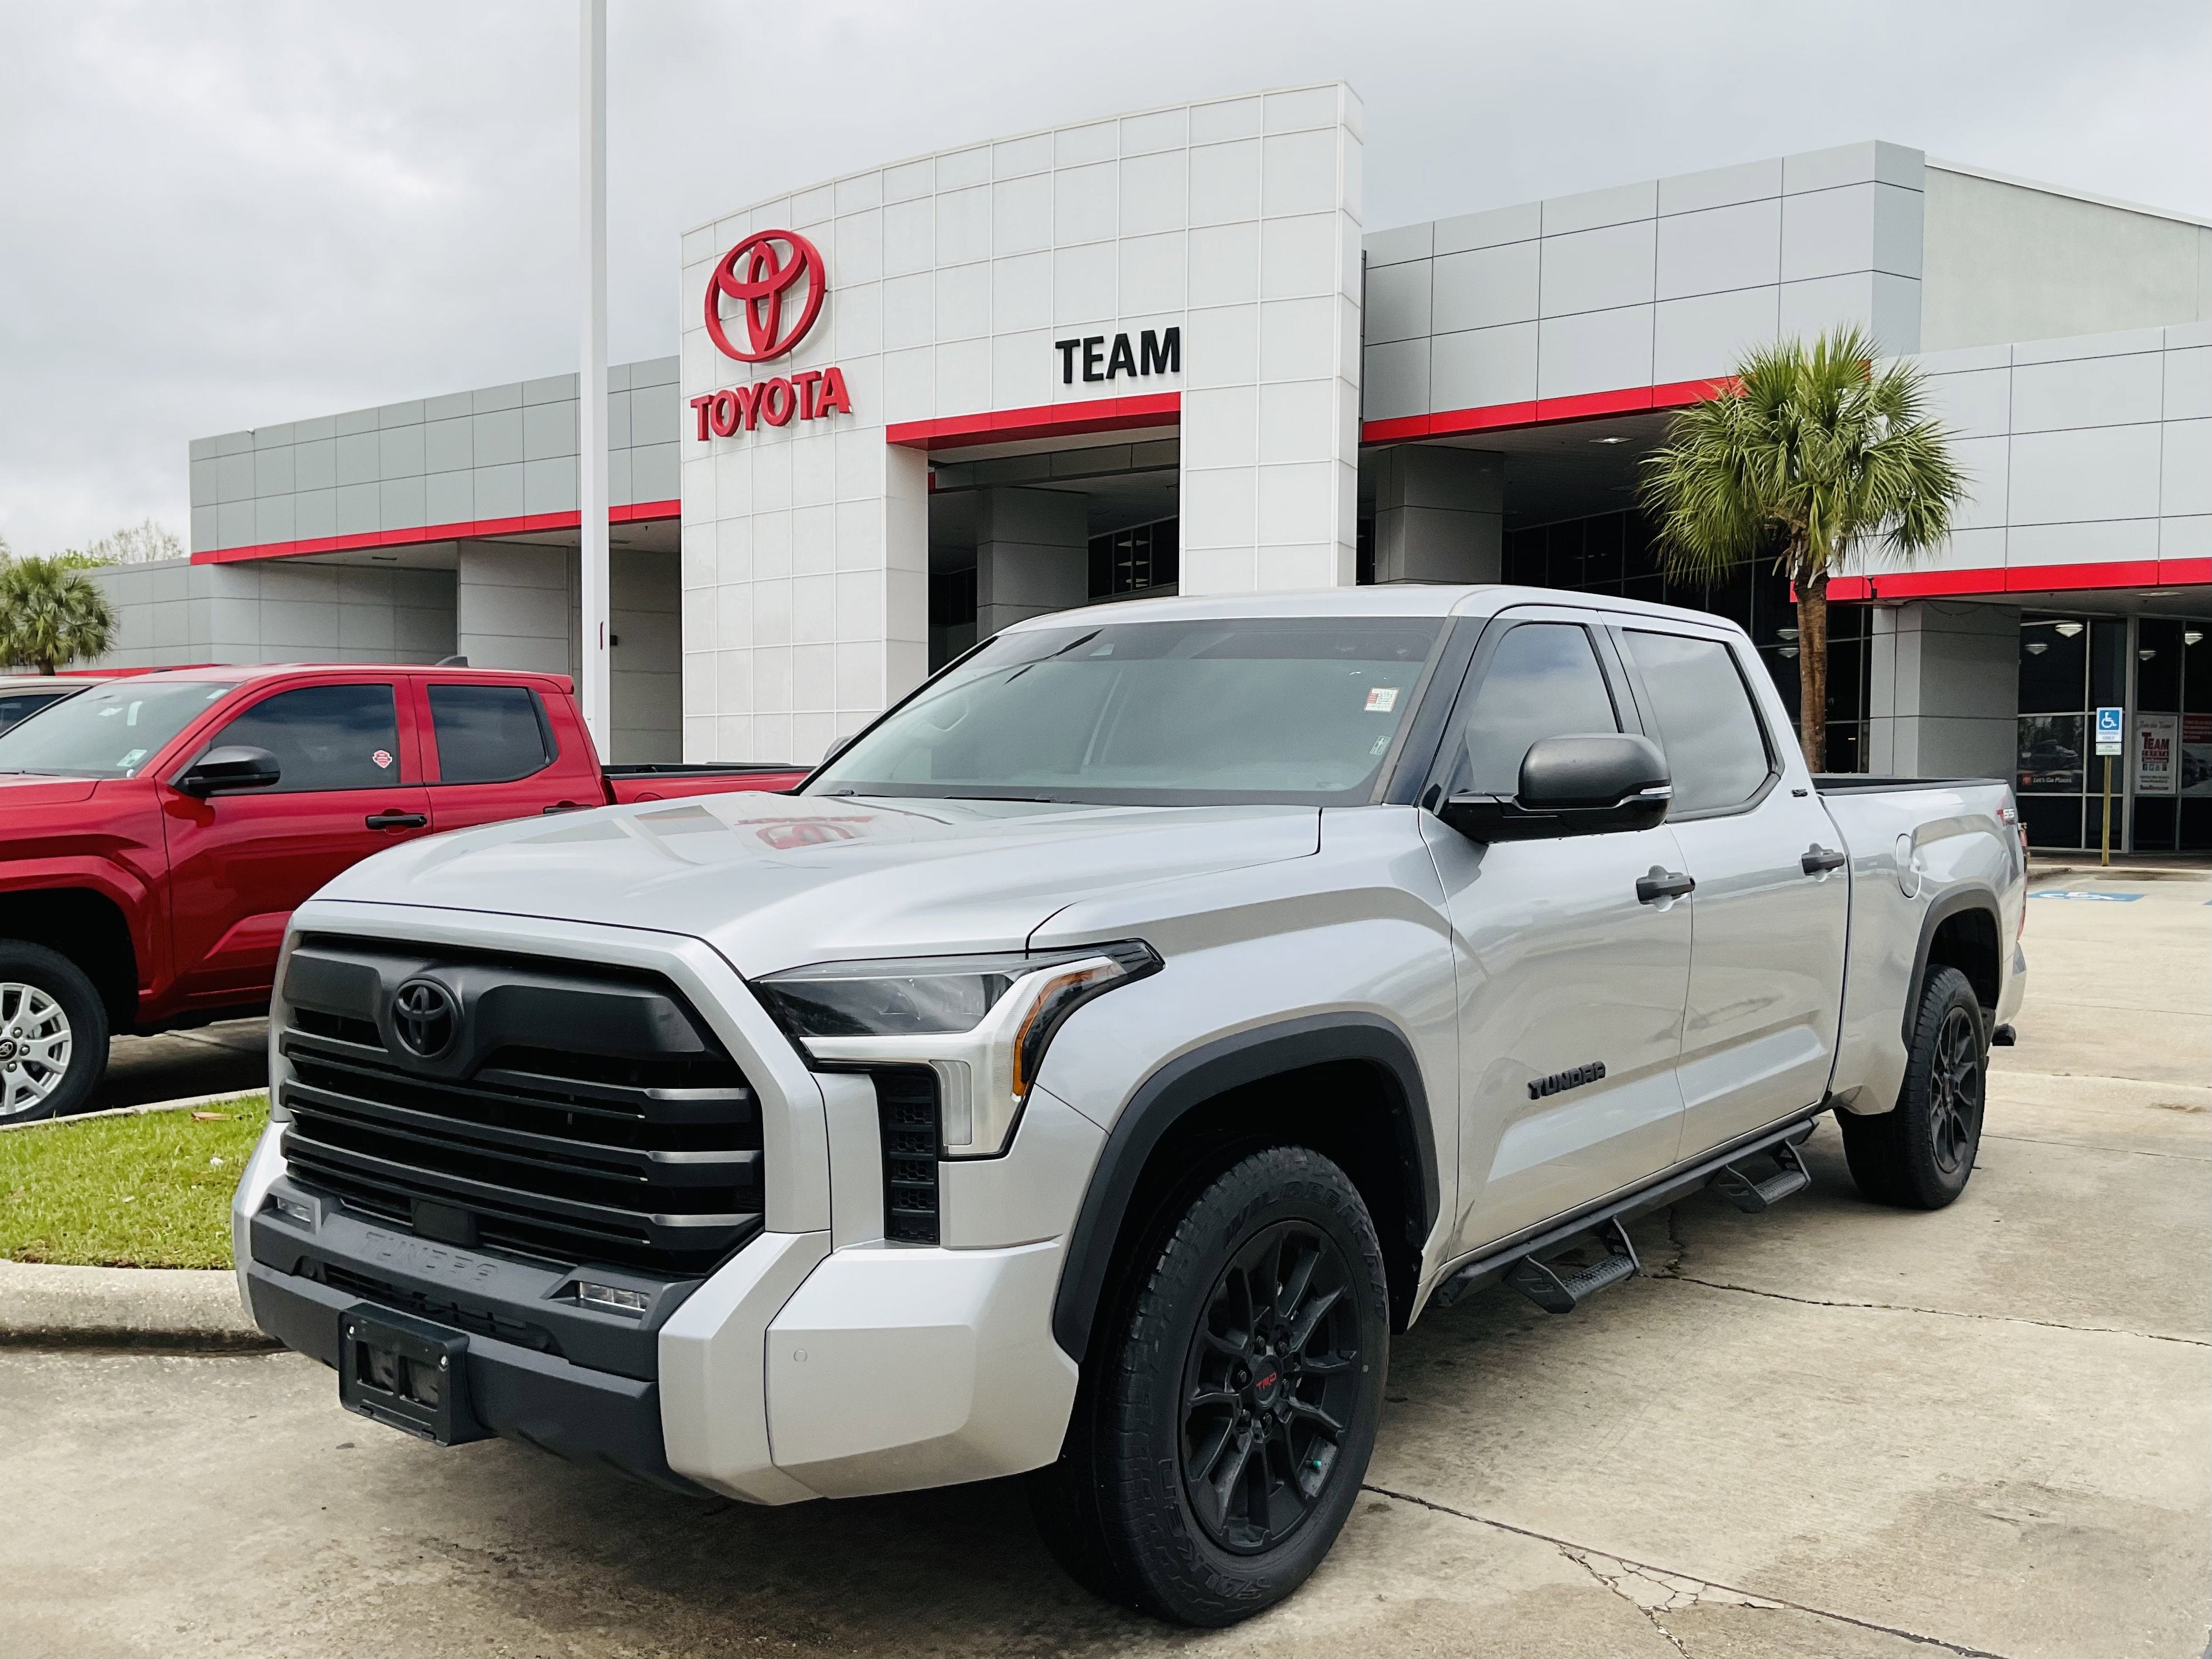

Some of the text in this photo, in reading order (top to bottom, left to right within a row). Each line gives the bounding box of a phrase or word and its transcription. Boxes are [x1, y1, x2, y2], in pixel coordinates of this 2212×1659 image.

[1055, 327, 1180, 384] TEAM
[690, 367, 852, 441] TOYOTA
[1527, 1061, 1606, 1100] TUNDRA
[1256, 1371, 1277, 1390] TRD
